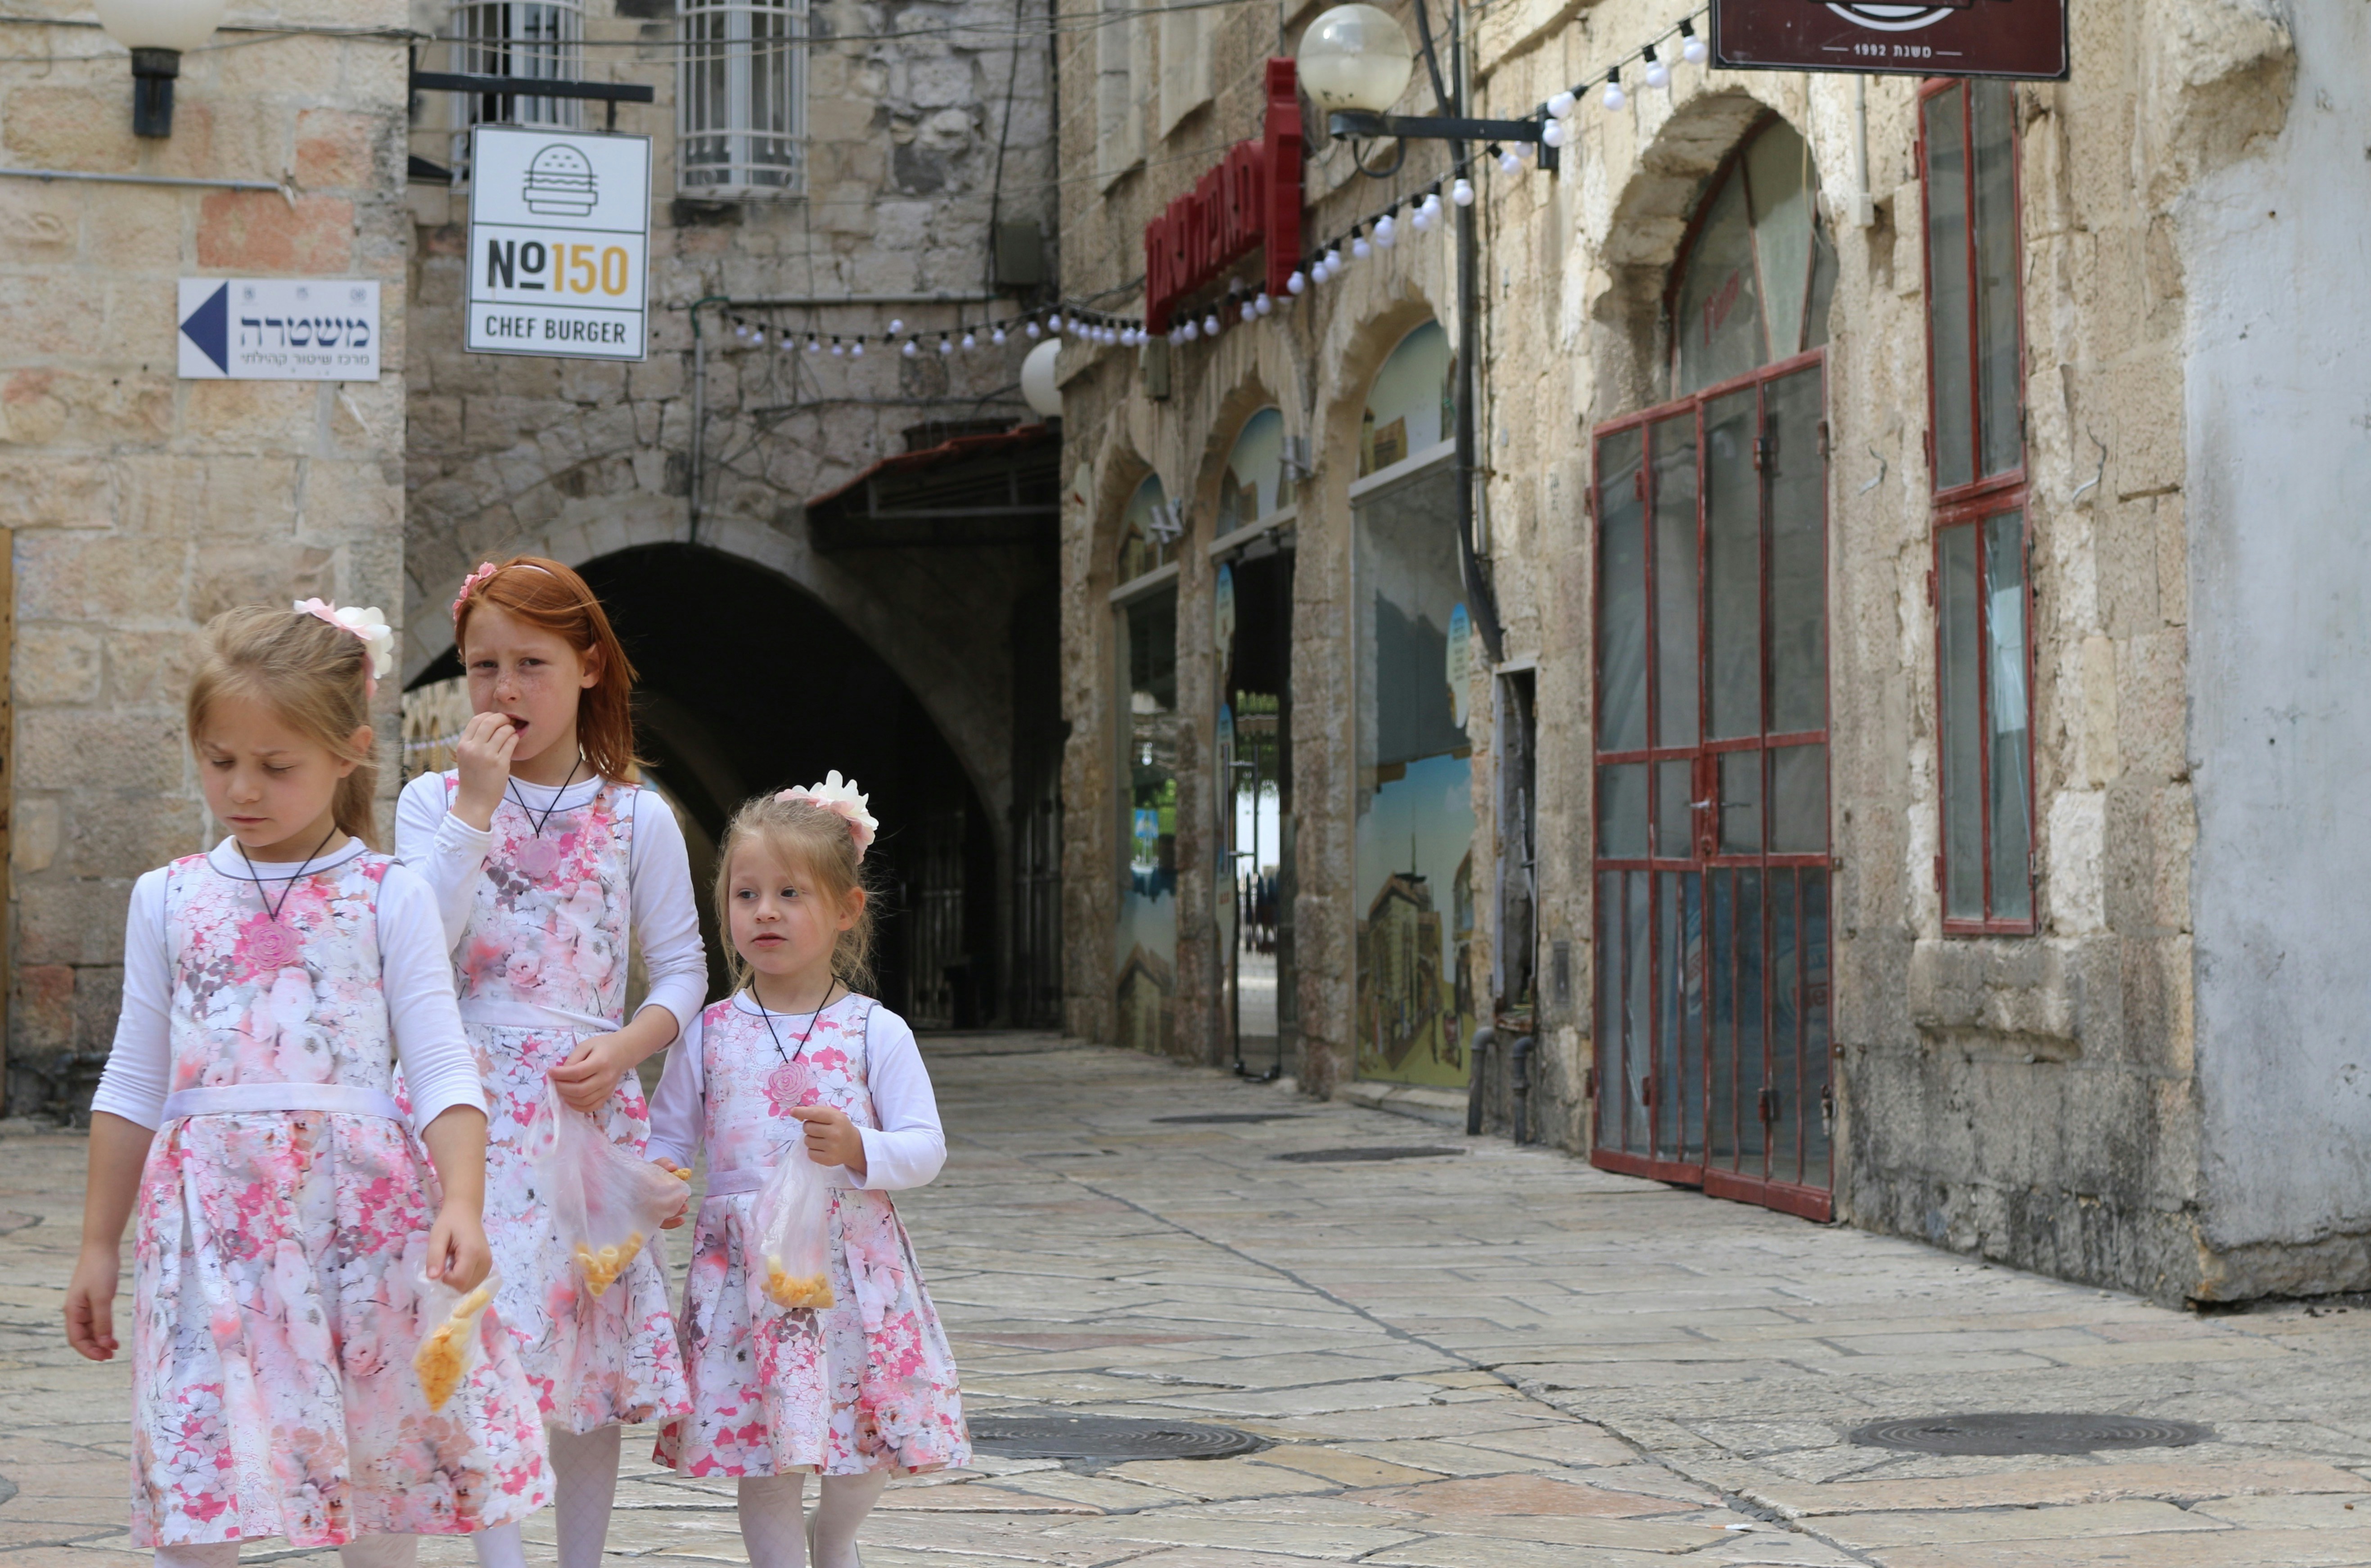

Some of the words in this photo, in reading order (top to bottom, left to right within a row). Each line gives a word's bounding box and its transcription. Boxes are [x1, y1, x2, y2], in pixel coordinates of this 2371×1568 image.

[1853, 43, 1886, 56] 1992
[241, 316, 370, 347] משטרה
[486, 315, 537, 338] CHEF
[545, 320, 626, 343] BURGER
[240, 350, 287, 366] קהילתי
[293, 353, 332, 365] שיטור
[338, 354, 370, 365] מרכז
